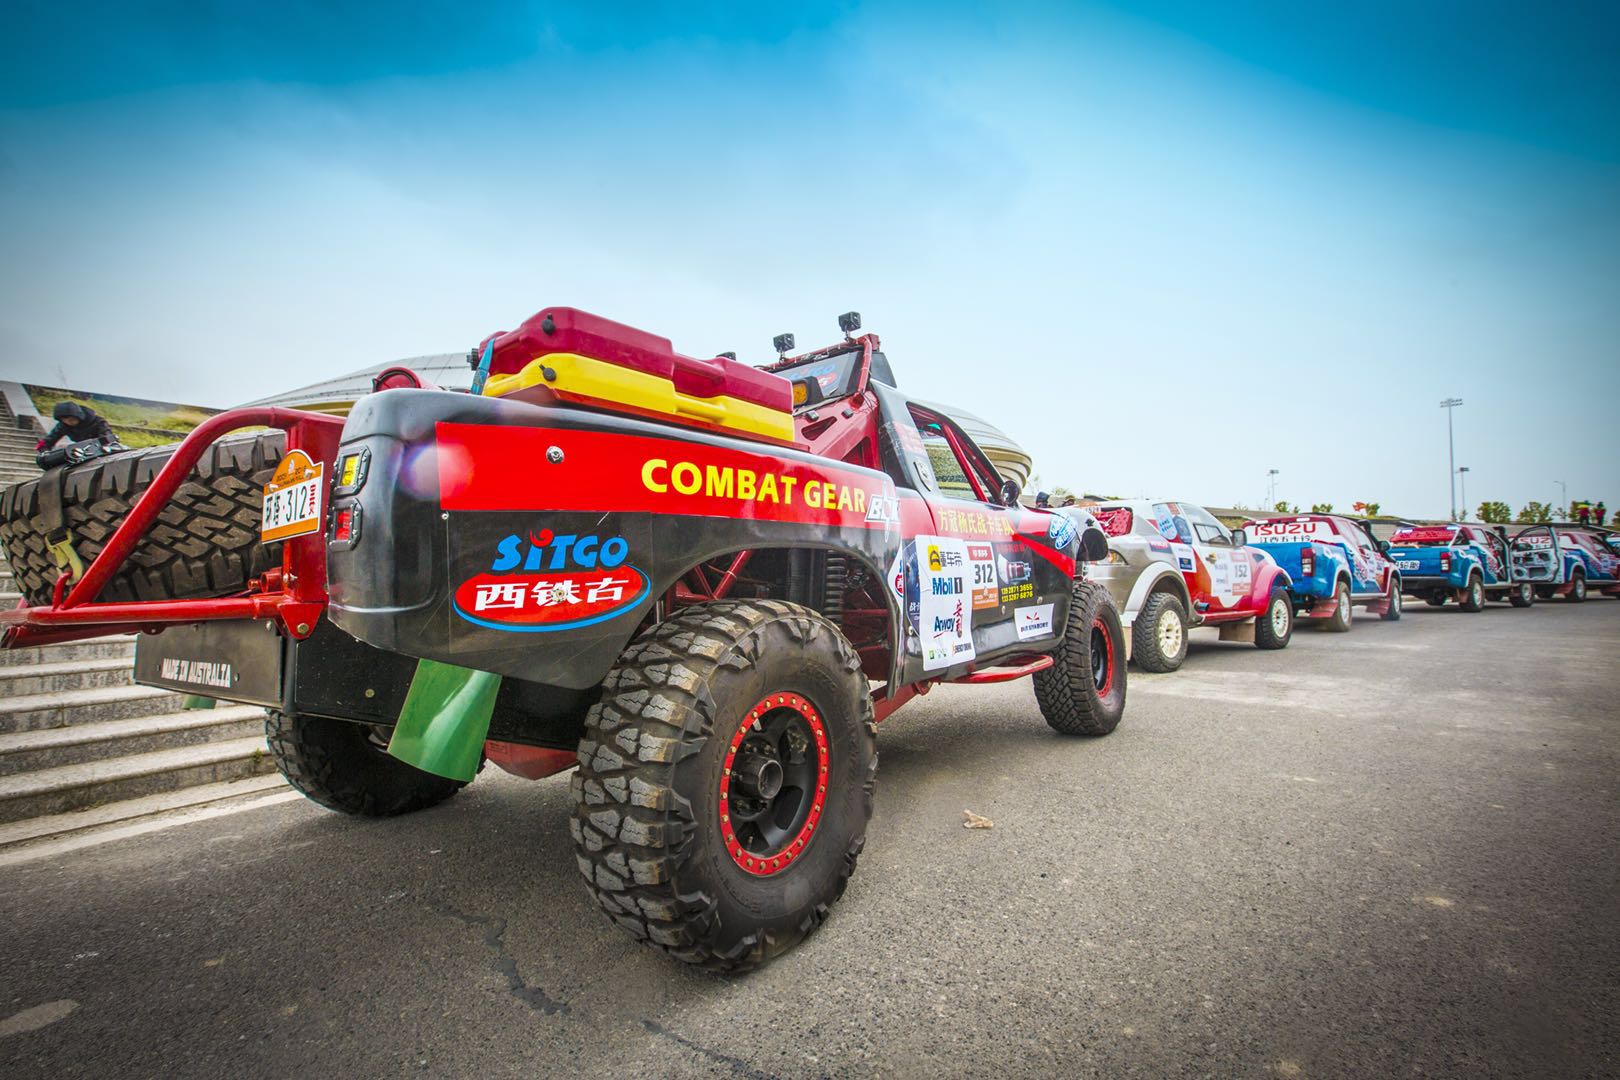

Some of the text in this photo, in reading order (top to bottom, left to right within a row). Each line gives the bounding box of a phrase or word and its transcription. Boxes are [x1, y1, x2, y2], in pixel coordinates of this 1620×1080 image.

[641, 458, 866, 513] COMBAT GEAR
[1254, 522, 1316, 537] ISUZU
[974, 563, 994, 585] 312
[1233, 564, 1248, 578] 152
[474, 576, 630, 611] 西铁古
[161, 657, 232, 689] MADE IN AUSTRALIA
